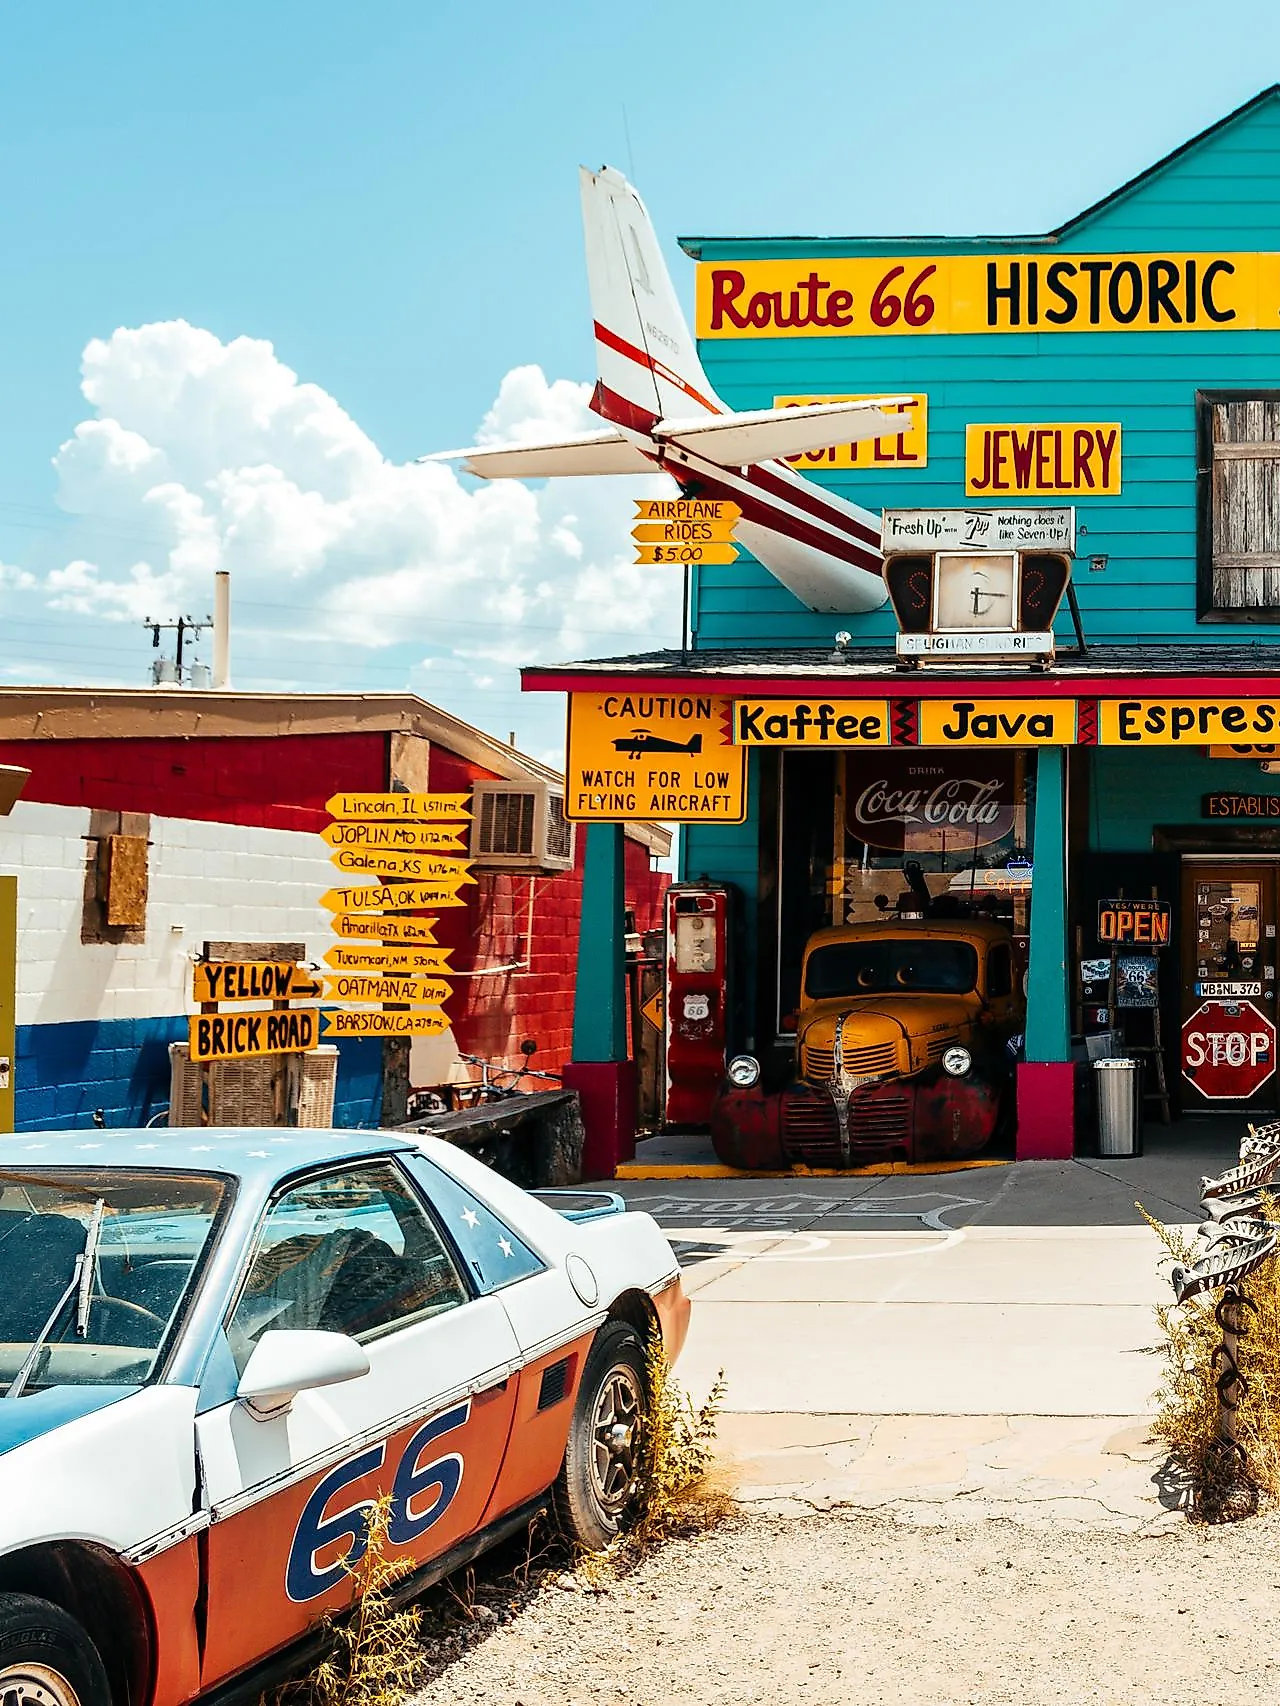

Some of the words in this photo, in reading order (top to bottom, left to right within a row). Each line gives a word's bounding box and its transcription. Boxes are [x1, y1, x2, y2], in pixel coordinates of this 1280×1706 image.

[711, 270, 853, 329] Route
[870, 264, 936, 327] 66
[987, 260, 1236, 325] HISTORIC
[971, 430, 1117, 490] JEWELRY
[648, 501, 723, 518] AIRPLANE
[997, 514, 1032, 527] Nothing
[1034, 514, 1055, 526] does
[1057, 514, 1065, 525] it
[664, 523, 712, 540] RIDES
[652, 546, 703, 562] $5.00
[604, 697, 712, 719] CAUTION
[738, 704, 881, 741] Kaffee
[942, 702, 1054, 739] Java
[582, 770, 635, 787] WATCH
[648, 771, 681, 788] FOR
[694, 772, 730, 789] LOW
[908, 767, 945, 775] DRINK
[402, 797, 419, 813] IL
[578, 793, 636, 811] FLYING
[650, 794, 731, 812] AIRCRAFT
[403, 859, 421, 873] KS
[398, 890, 416, 904] OK
[1100, 911, 1168, 942] OPEN
[205, 966, 292, 998] YELLOW
[338, 979, 401, 1000] OATMAN,
[402, 983, 417, 998] AZ
[1202, 984, 1215, 994] WB
[1223, 984, 1237, 994] NL
[1240, 984, 1260, 994] 376
[687, 1006, 704, 1015] 66
[199, 1016, 261, 1055] BRICK
[267, 1014, 312, 1049] ROAD
[1186, 1032, 1270, 1066] STOP
[286, 1402, 472, 1602] 66
